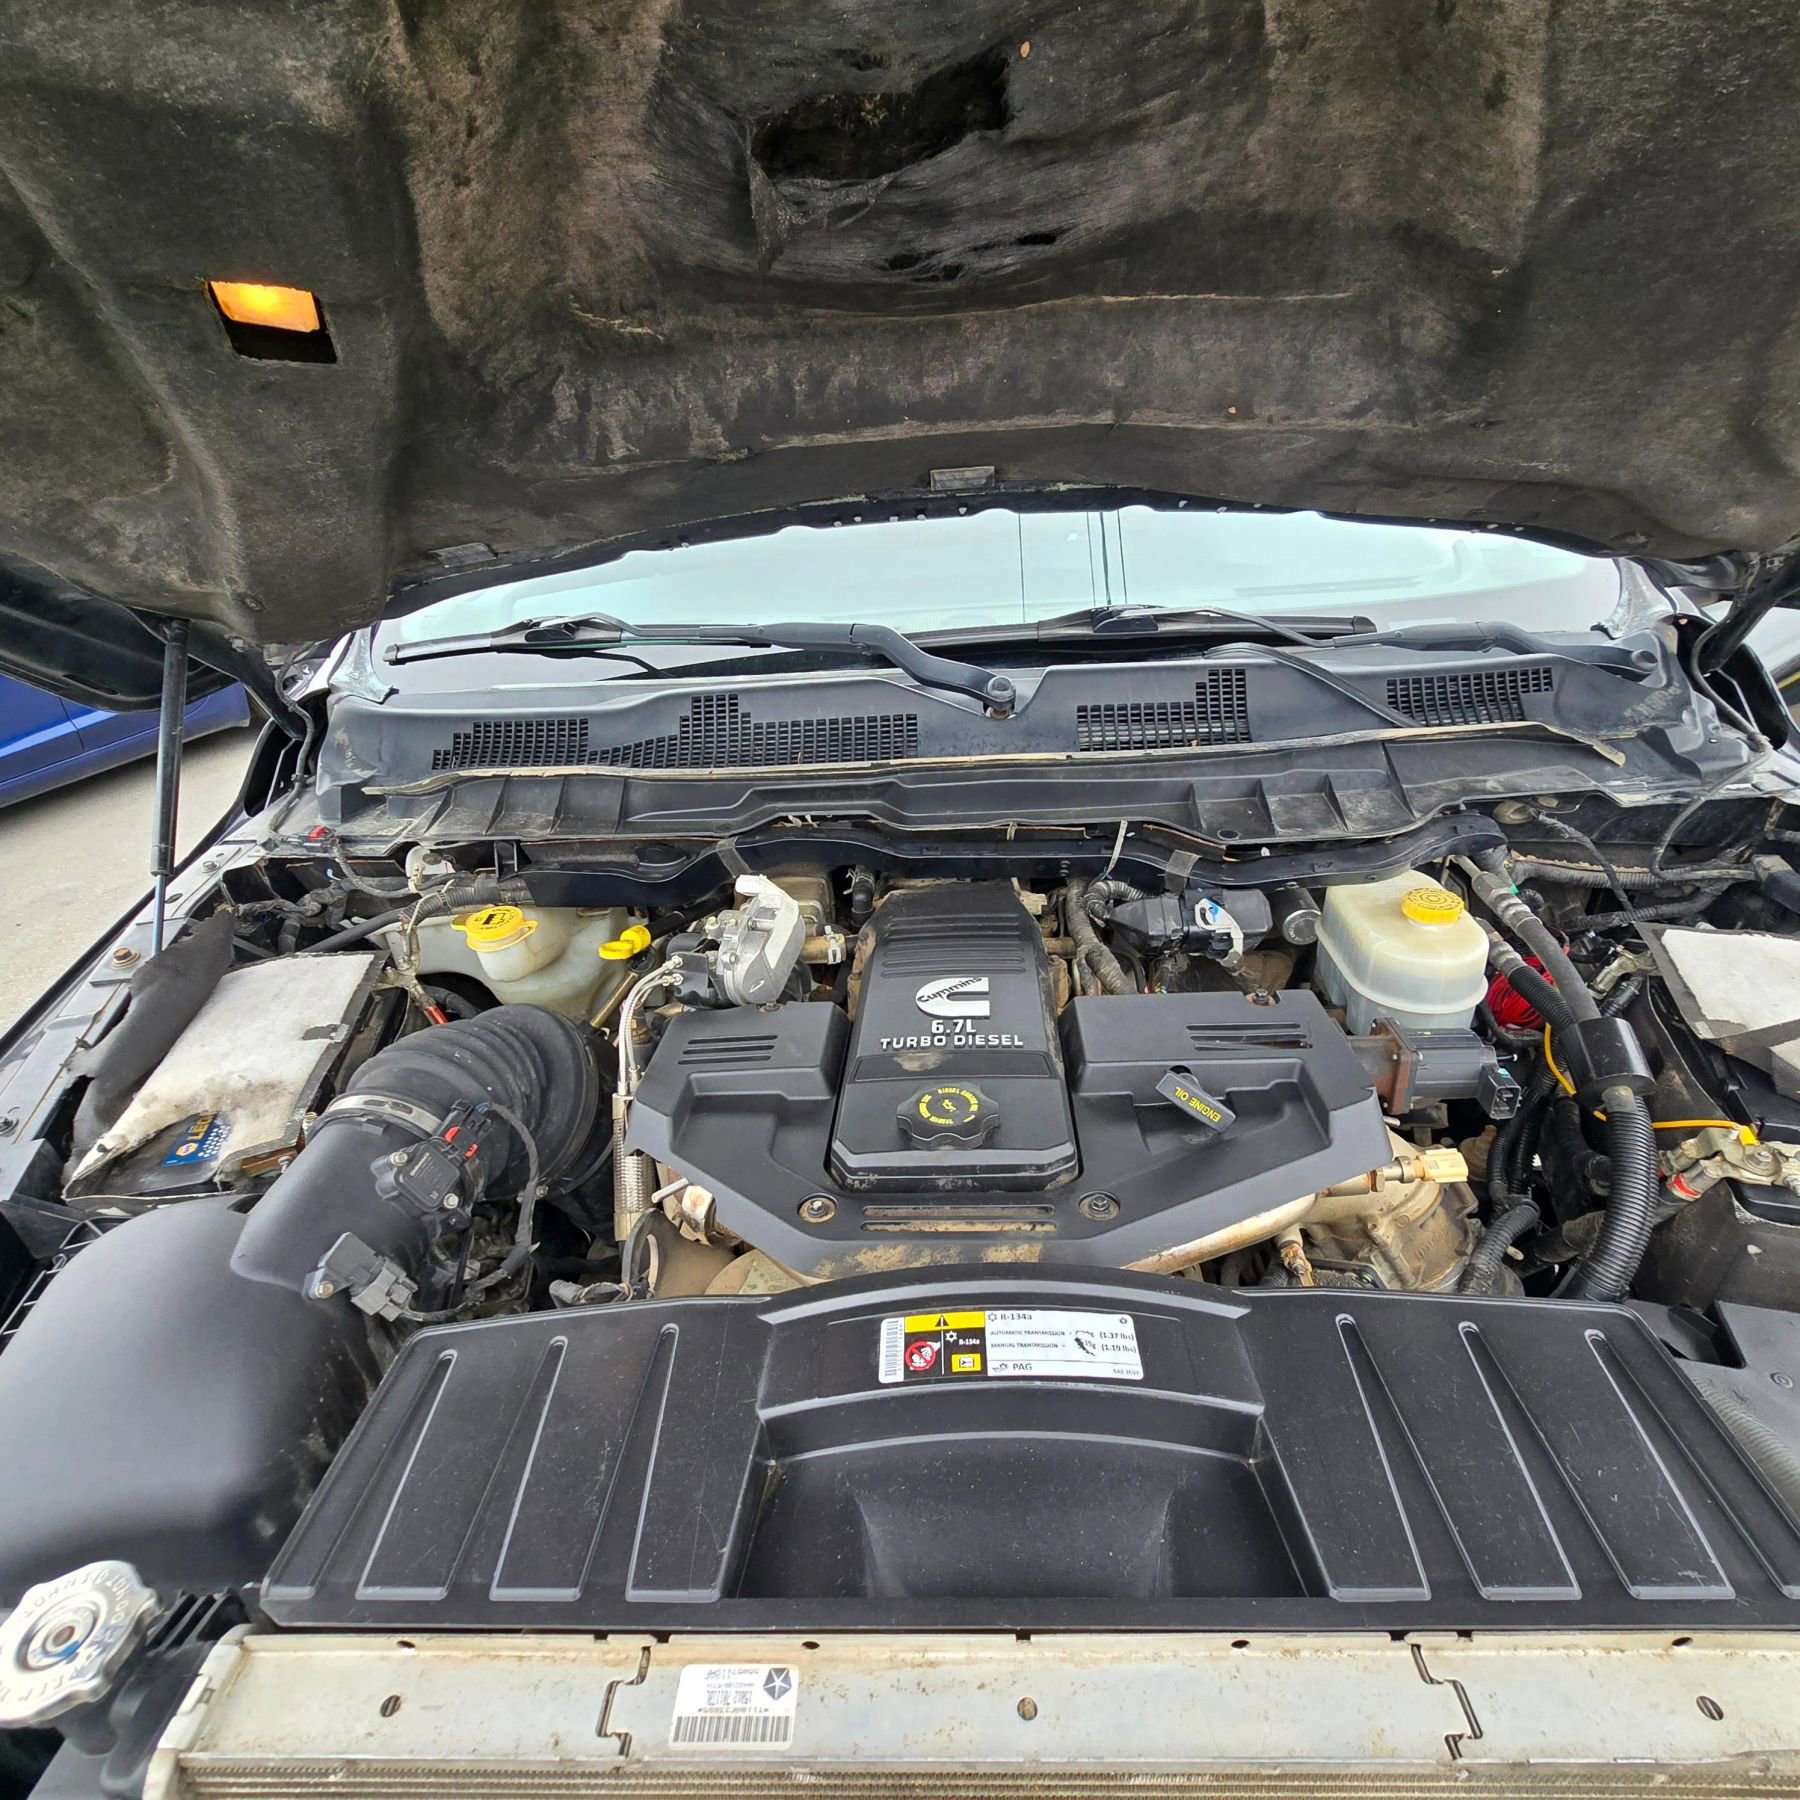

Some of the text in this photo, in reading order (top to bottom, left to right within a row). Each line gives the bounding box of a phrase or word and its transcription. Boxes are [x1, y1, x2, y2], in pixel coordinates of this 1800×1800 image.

[917, 978, 983, 1003] Cummins
[931, 1019, 977, 1034] 6.7L
[880, 1034, 1025, 1049] TURBO DIESEL
[1175, 1086, 1222, 1123] ENGINE OIL
[1000, 1313, 1032, 1321] R-134a
[1012, 1363, 1032, 1371] PAG
